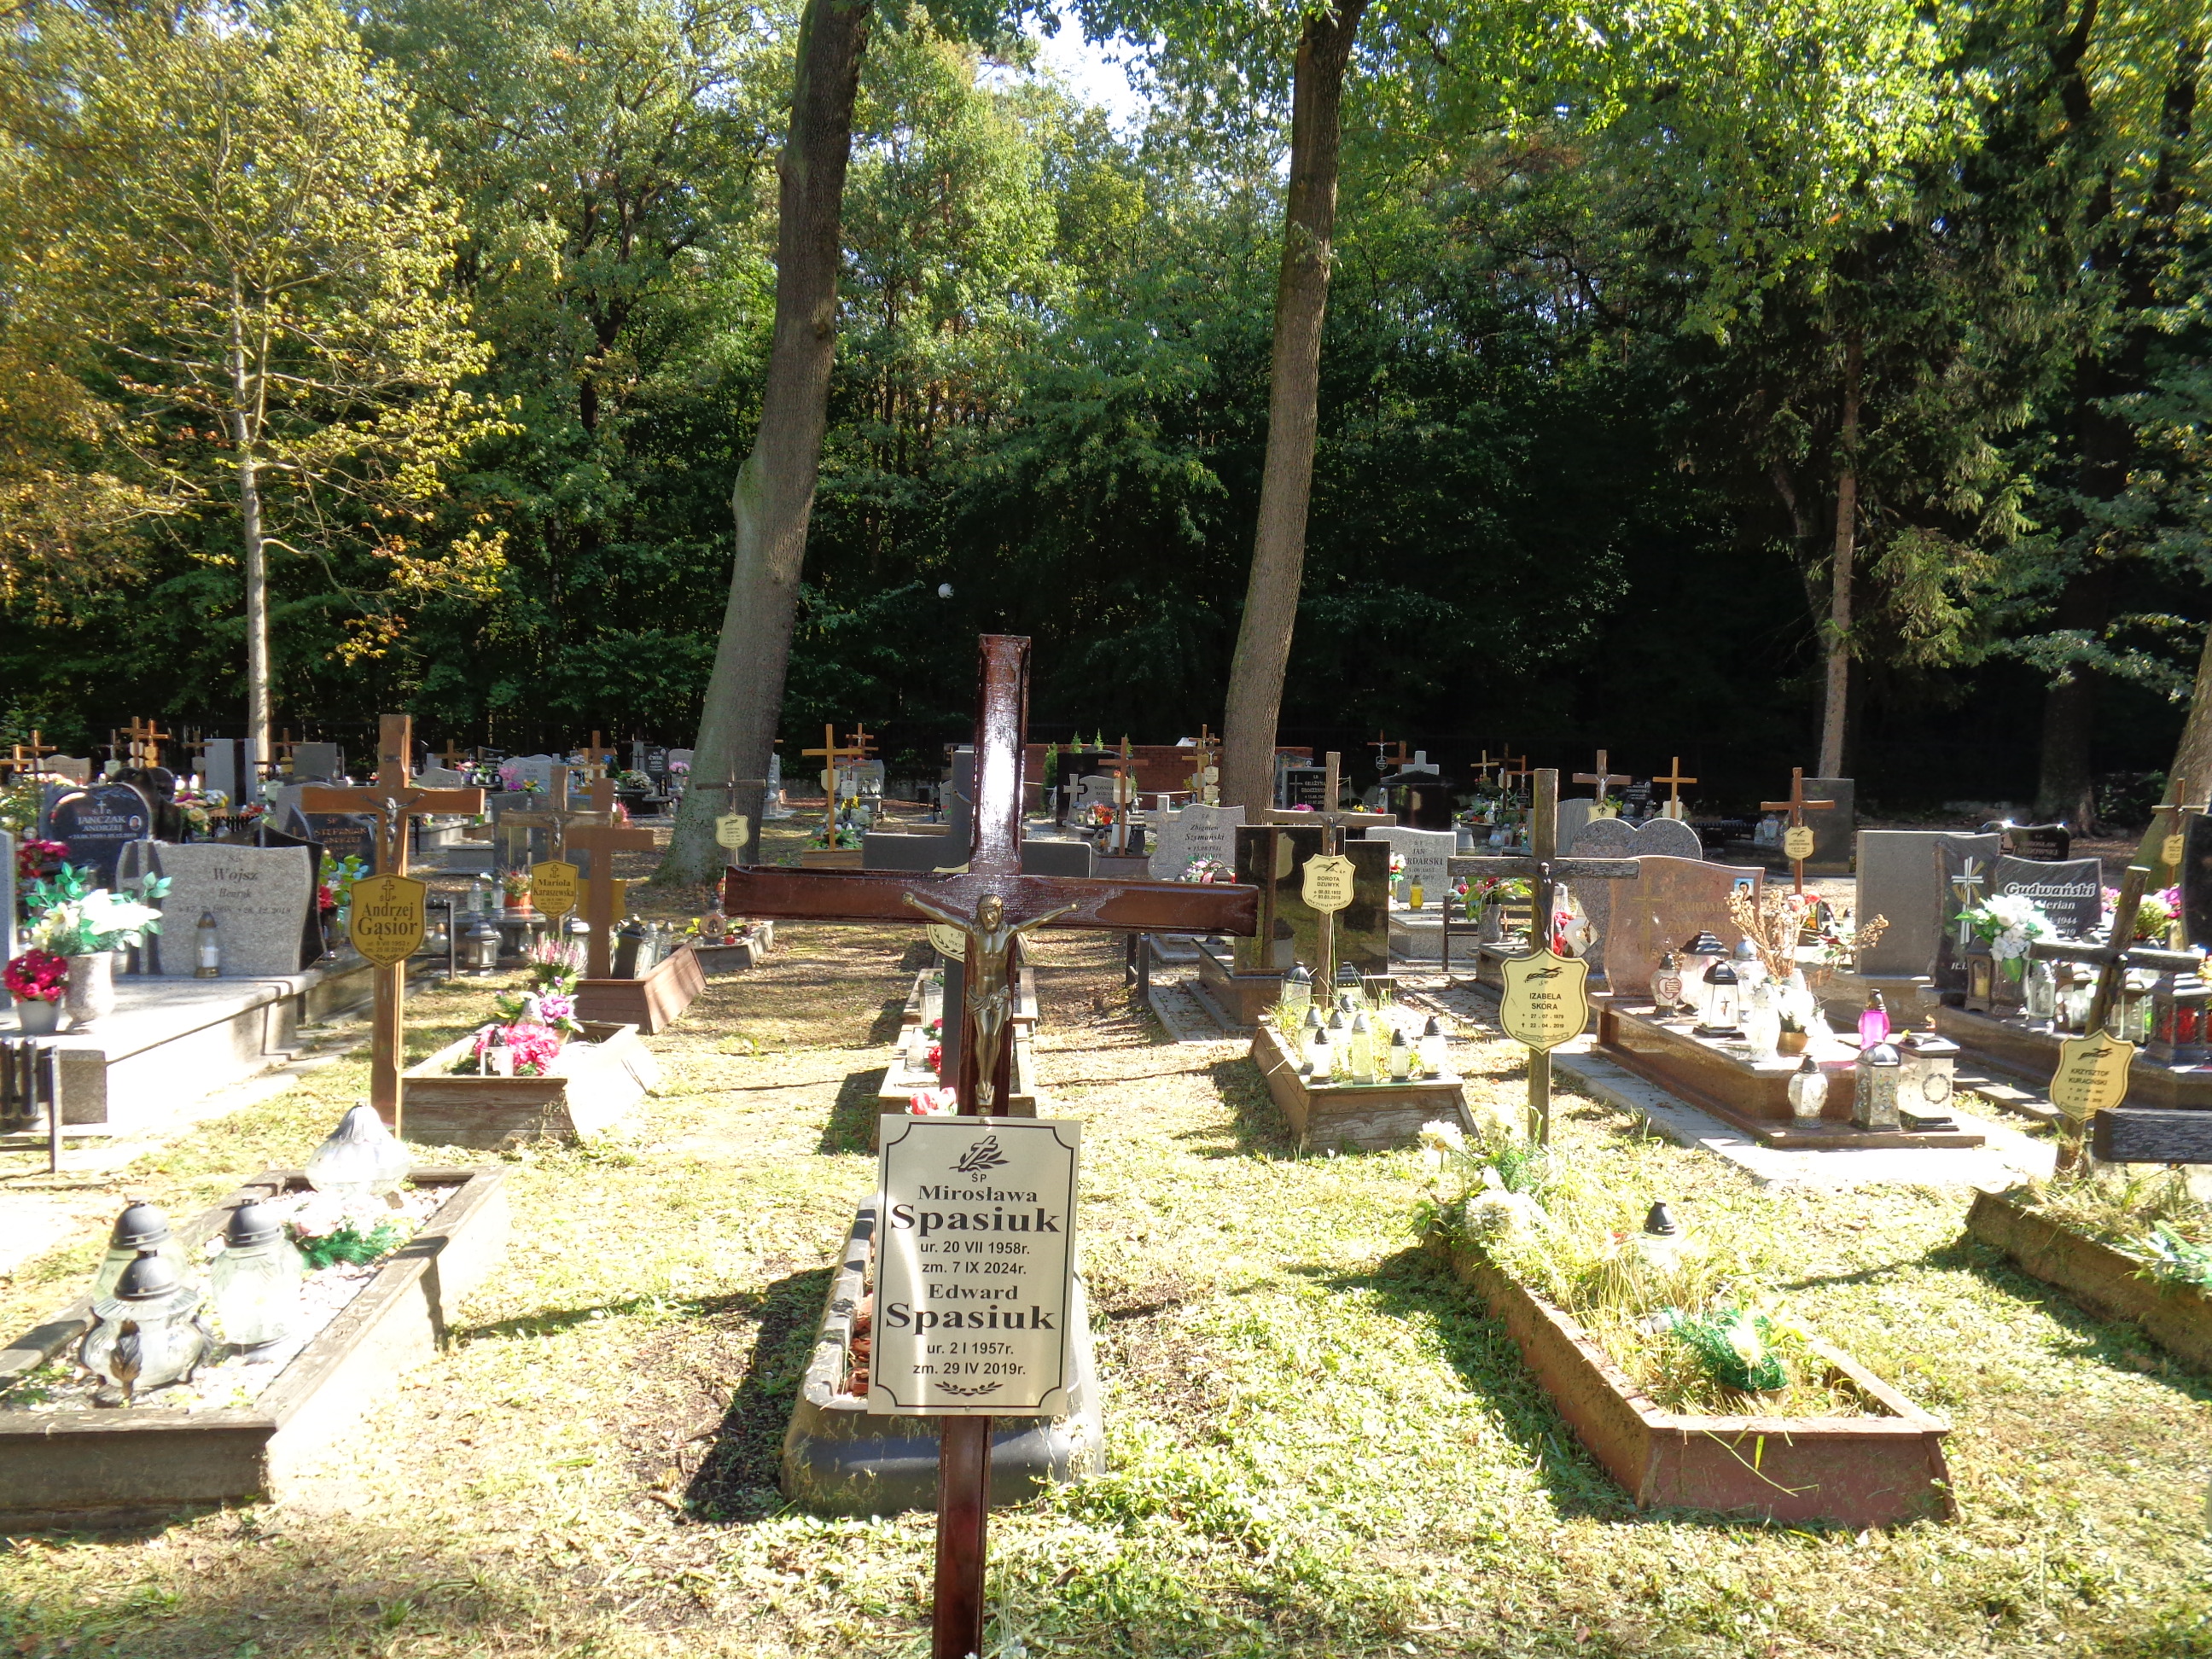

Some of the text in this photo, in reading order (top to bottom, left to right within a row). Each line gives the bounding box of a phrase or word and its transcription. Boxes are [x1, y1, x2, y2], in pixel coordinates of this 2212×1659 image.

[78, 815, 126, 825] JANCZAK
[213, 868, 259, 883] Wojsz
[538, 878, 571, 887] Mariola
[218, 888, 252, 899] Henryk
[2004, 882, 2097, 897] Gudwański
[362, 902, 413, 921] Andrzej
[358, 917, 417, 940] Gąsior
[1531, 1000, 1558, 1010] SKÓRA
[2070, 1068, 2110, 1077] KRZYSZTOF
[918, 1185, 1038, 1202] Mirosława
[890, 1204, 1061, 1237] Spasiuk
[920, 1241, 1030, 1254] ur. 20 VII 1958r.
[922, 1261, 1027, 1275] zm. 7 IX 2024r.
[928, 1284, 1018, 1300] Edward
[886, 1302, 1056, 1336] Spasiuk
[927, 1344, 945, 1354] ur.
[950, 1342, 958, 1354] 2
[971, 1342, 1014, 1354] 1957r.
[913, 1363, 1026, 1375] zm. 29 IV 2019r.
